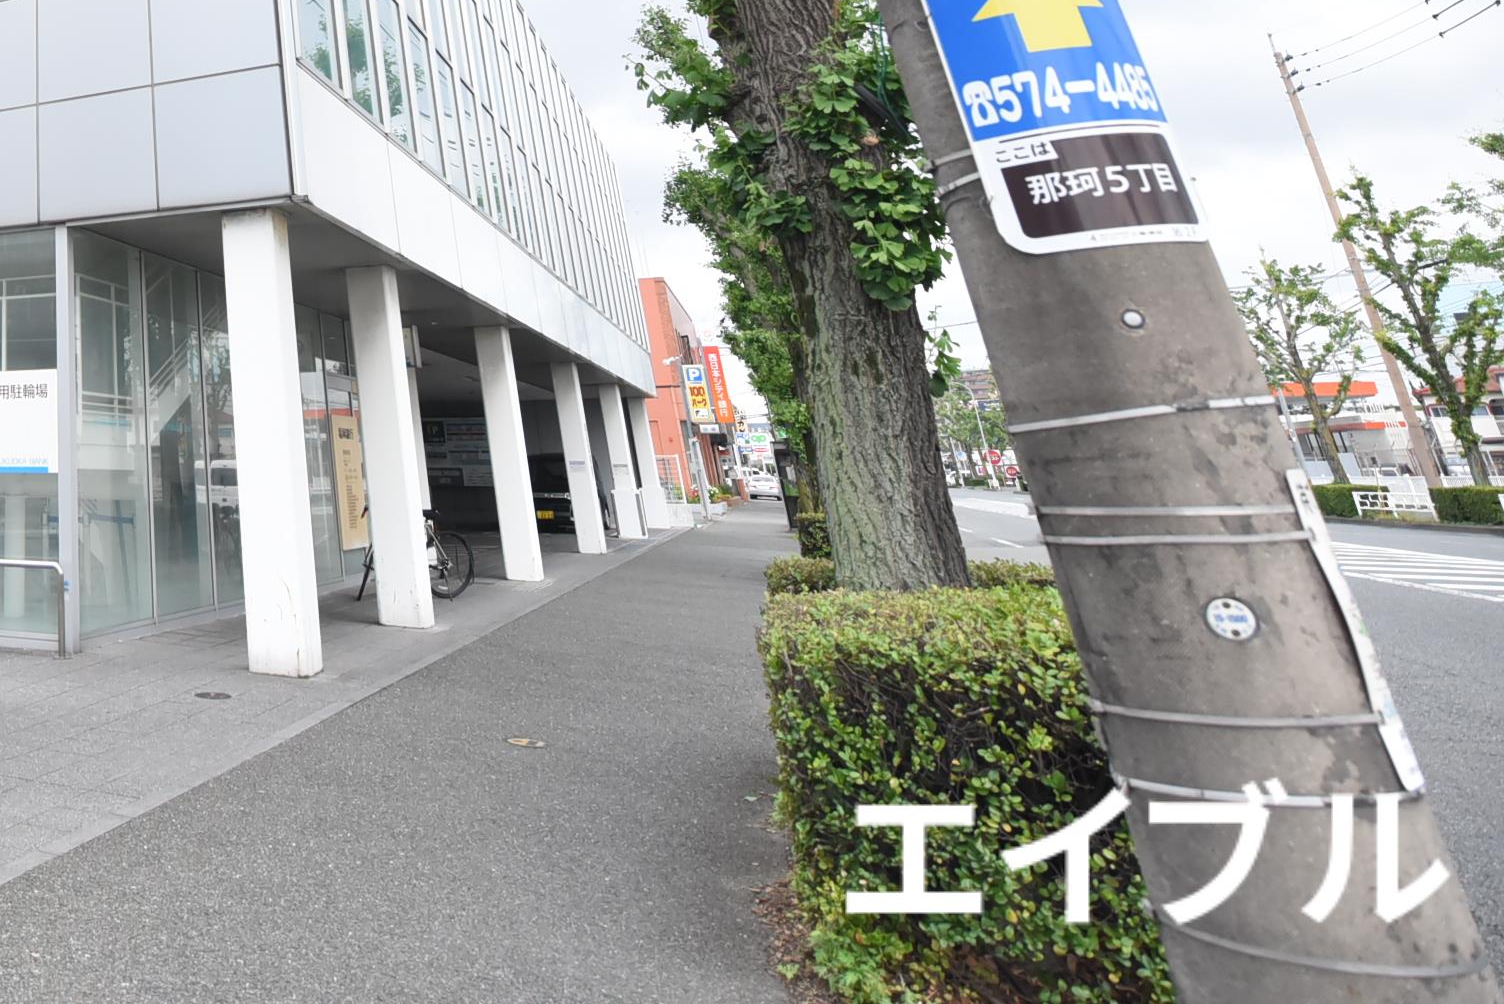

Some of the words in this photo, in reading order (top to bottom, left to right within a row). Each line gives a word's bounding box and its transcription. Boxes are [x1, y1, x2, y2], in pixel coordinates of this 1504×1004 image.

[990, 62, 1160, 123] 574-4485
[995, 141, 1051, 164] ここは
[1024, 162, 1178, 204] 那珂5丁目
